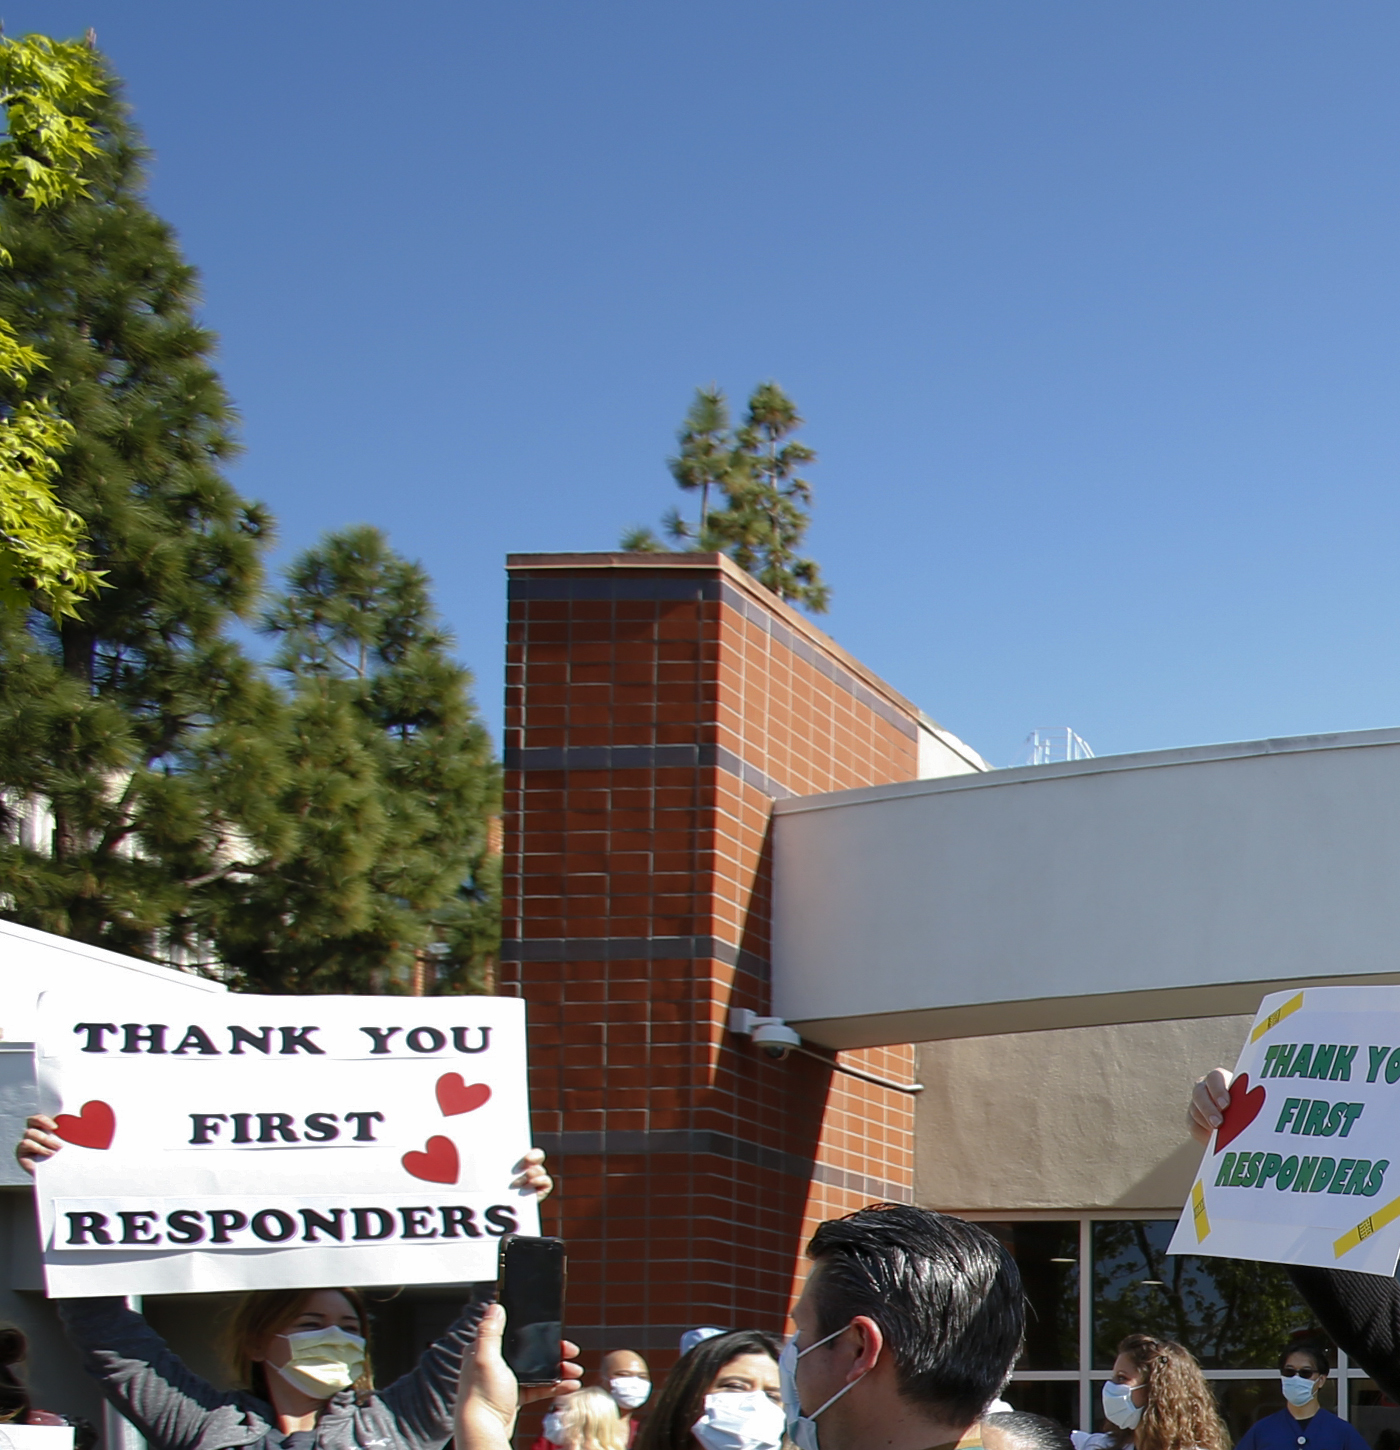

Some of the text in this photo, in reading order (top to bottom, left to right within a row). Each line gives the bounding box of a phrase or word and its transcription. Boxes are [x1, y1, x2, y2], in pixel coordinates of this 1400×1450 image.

[74, 1022, 492, 1056] THANK YOU
[1260, 1043, 1358, 1082] THANK
[188, 1111, 384, 1144] FIRST
[1275, 1098, 1365, 1138] FIRST
[1214, 1152, 1390, 1197] RESPONDERS
[65, 1204, 518, 1245] RESPONDERS
